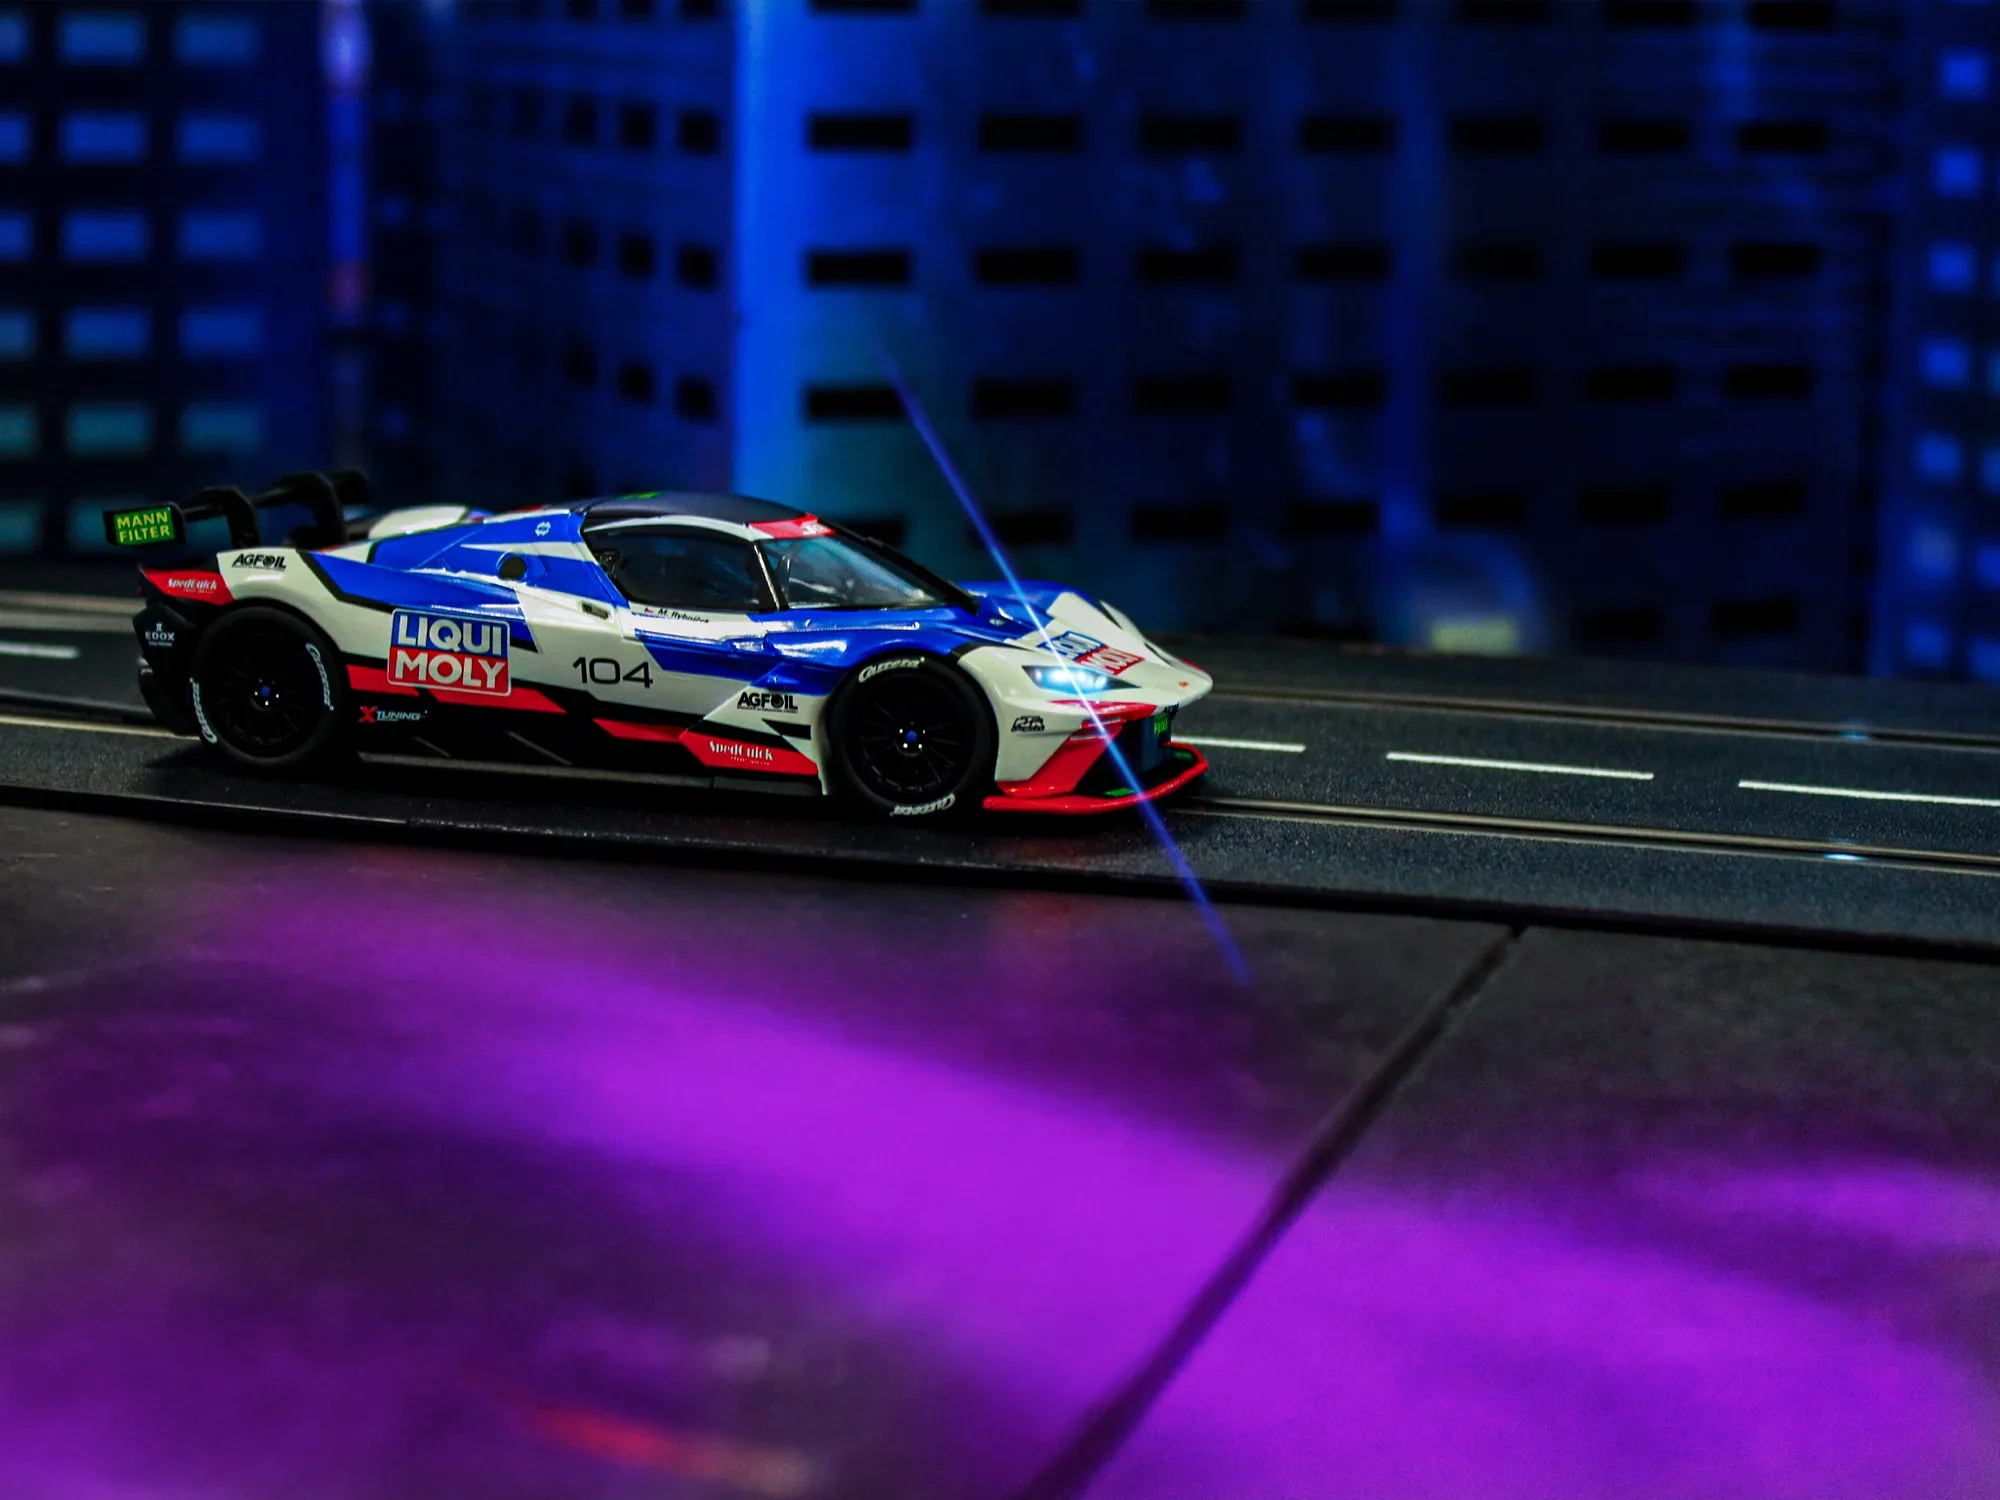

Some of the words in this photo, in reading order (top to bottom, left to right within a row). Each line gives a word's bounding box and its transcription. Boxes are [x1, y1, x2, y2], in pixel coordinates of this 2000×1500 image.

[116, 511, 168, 529] MANN
[118, 525, 171, 543] FILTER
[231, 553, 286, 569] AGFOIL
[145, 631, 175, 641] EDOX
[397, 615, 502, 655] LIQUI
[395, 650, 506, 689] MOLY
[572, 657, 654, 688] 104
[736, 691, 798, 710] AGFOIL
